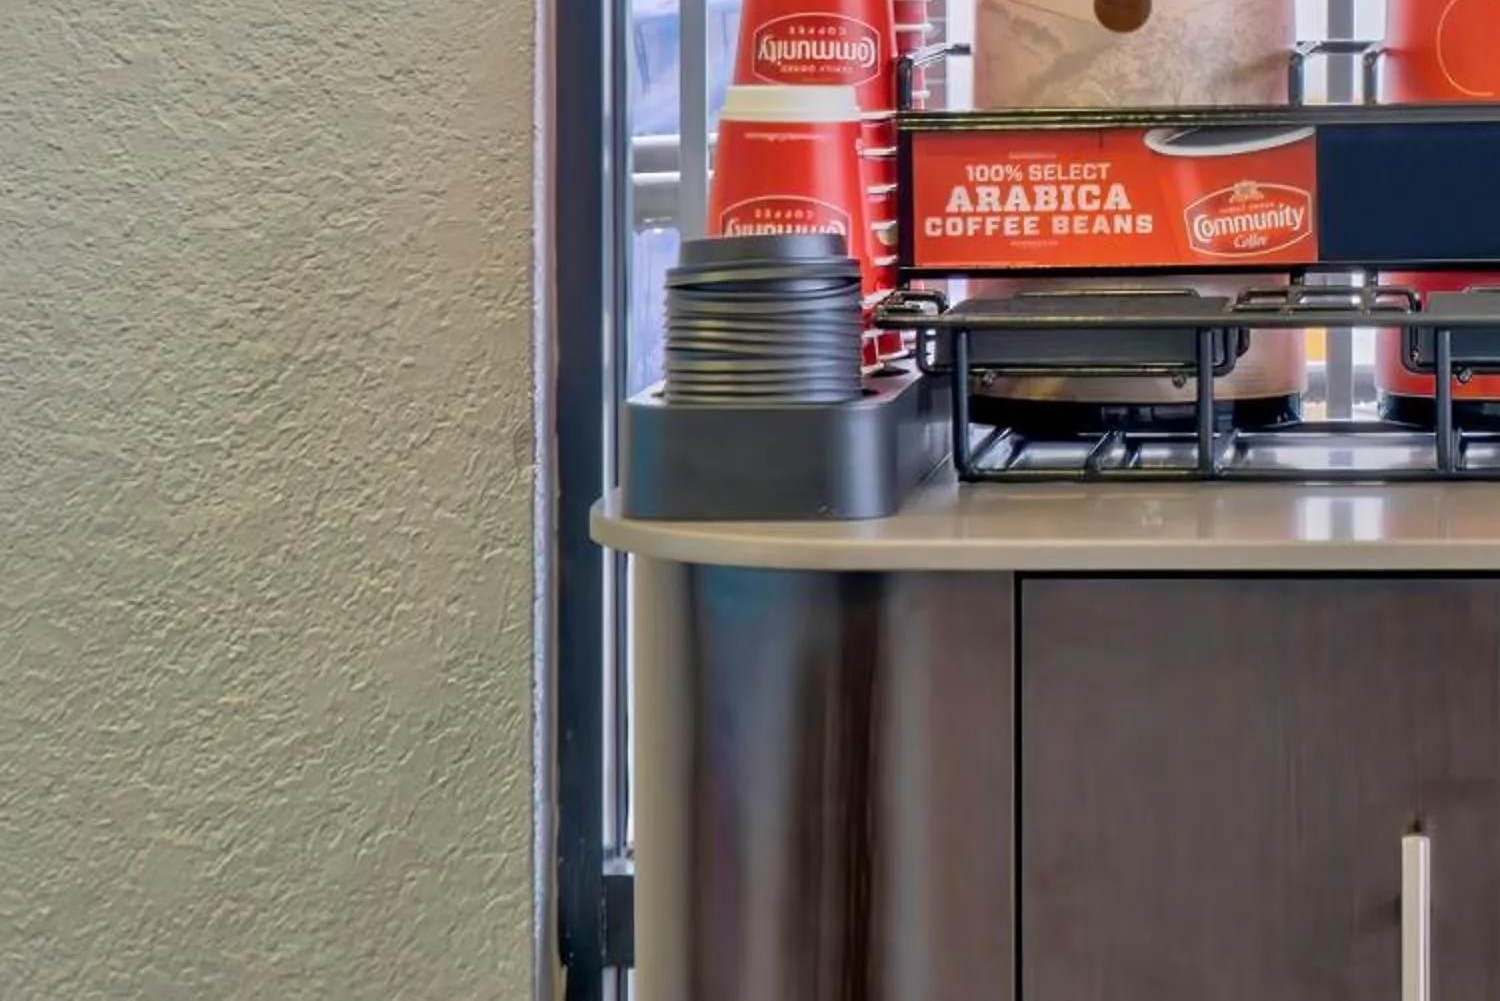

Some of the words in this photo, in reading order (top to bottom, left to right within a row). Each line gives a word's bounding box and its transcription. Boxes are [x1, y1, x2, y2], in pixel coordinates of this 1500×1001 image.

[757, 35, 878, 68] Community
[966, 164, 1023, 182] 100%
[1028, 163, 1111, 181] SELECT
[945, 183, 1132, 213] ARABICA
[924, 216, 1040, 237] COFFEE
[1052, 214, 1153, 235] BEANS
[1194, 203, 1305, 243] Community
